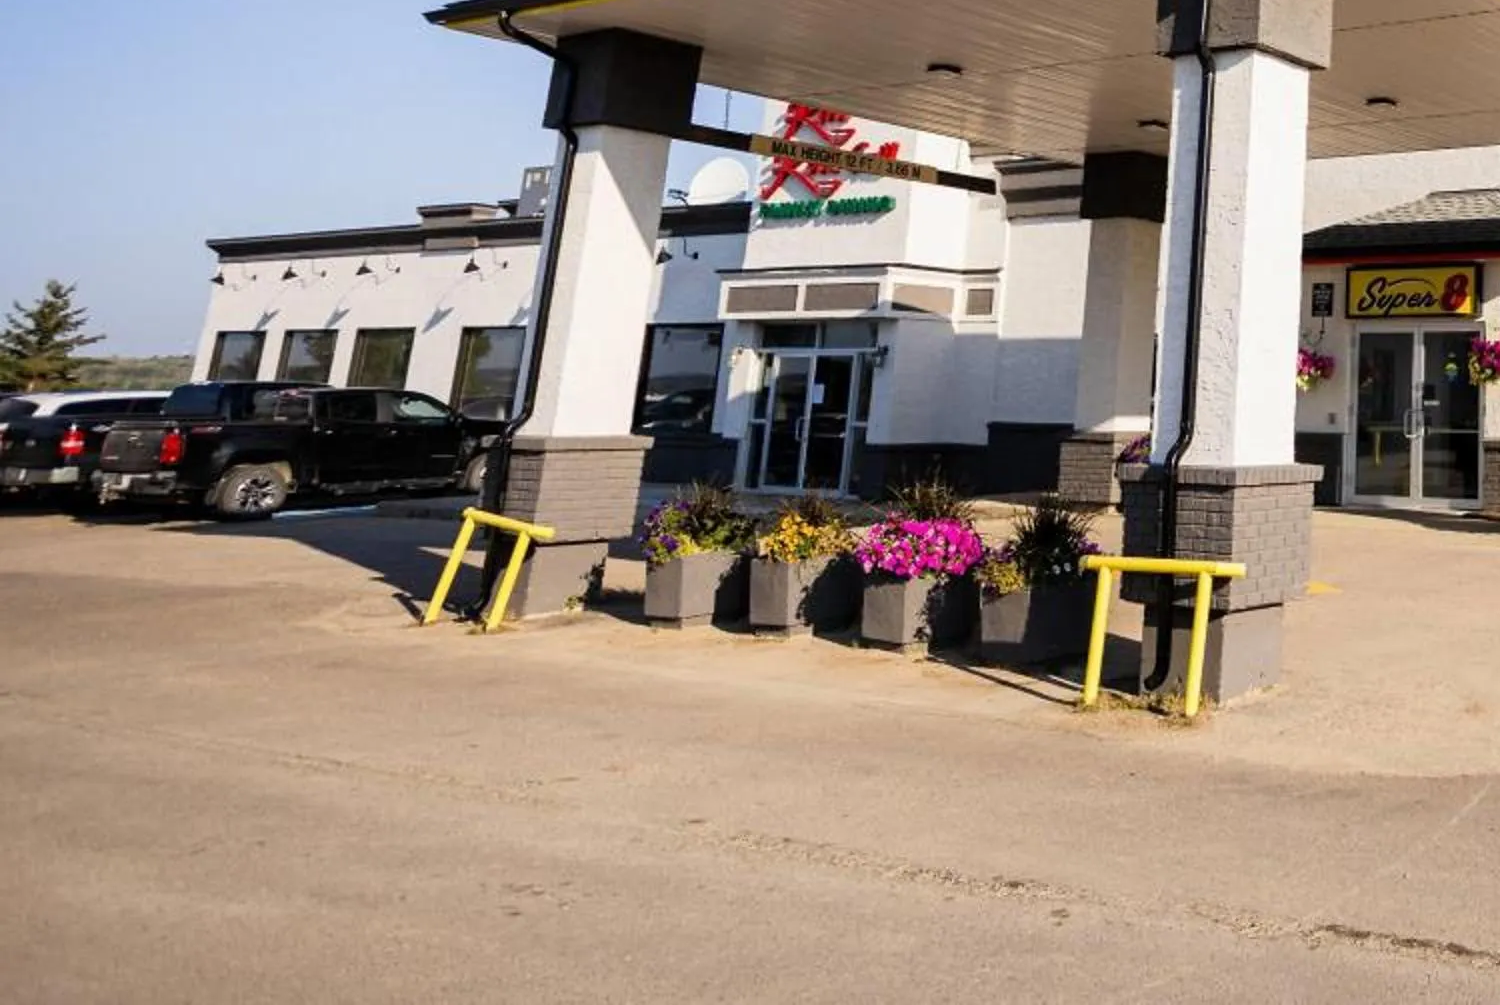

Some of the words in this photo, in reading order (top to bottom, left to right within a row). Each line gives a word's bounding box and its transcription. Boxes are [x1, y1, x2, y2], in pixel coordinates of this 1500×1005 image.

[772, 141, 796, 156] MAX
[801, 147, 840, 163] HEIGHT
[846, 155, 857, 167] 12
[860, 156, 873, 171] FT
[1358, 276, 1439, 316] Super
[1441, 273, 1469, 311] 8
